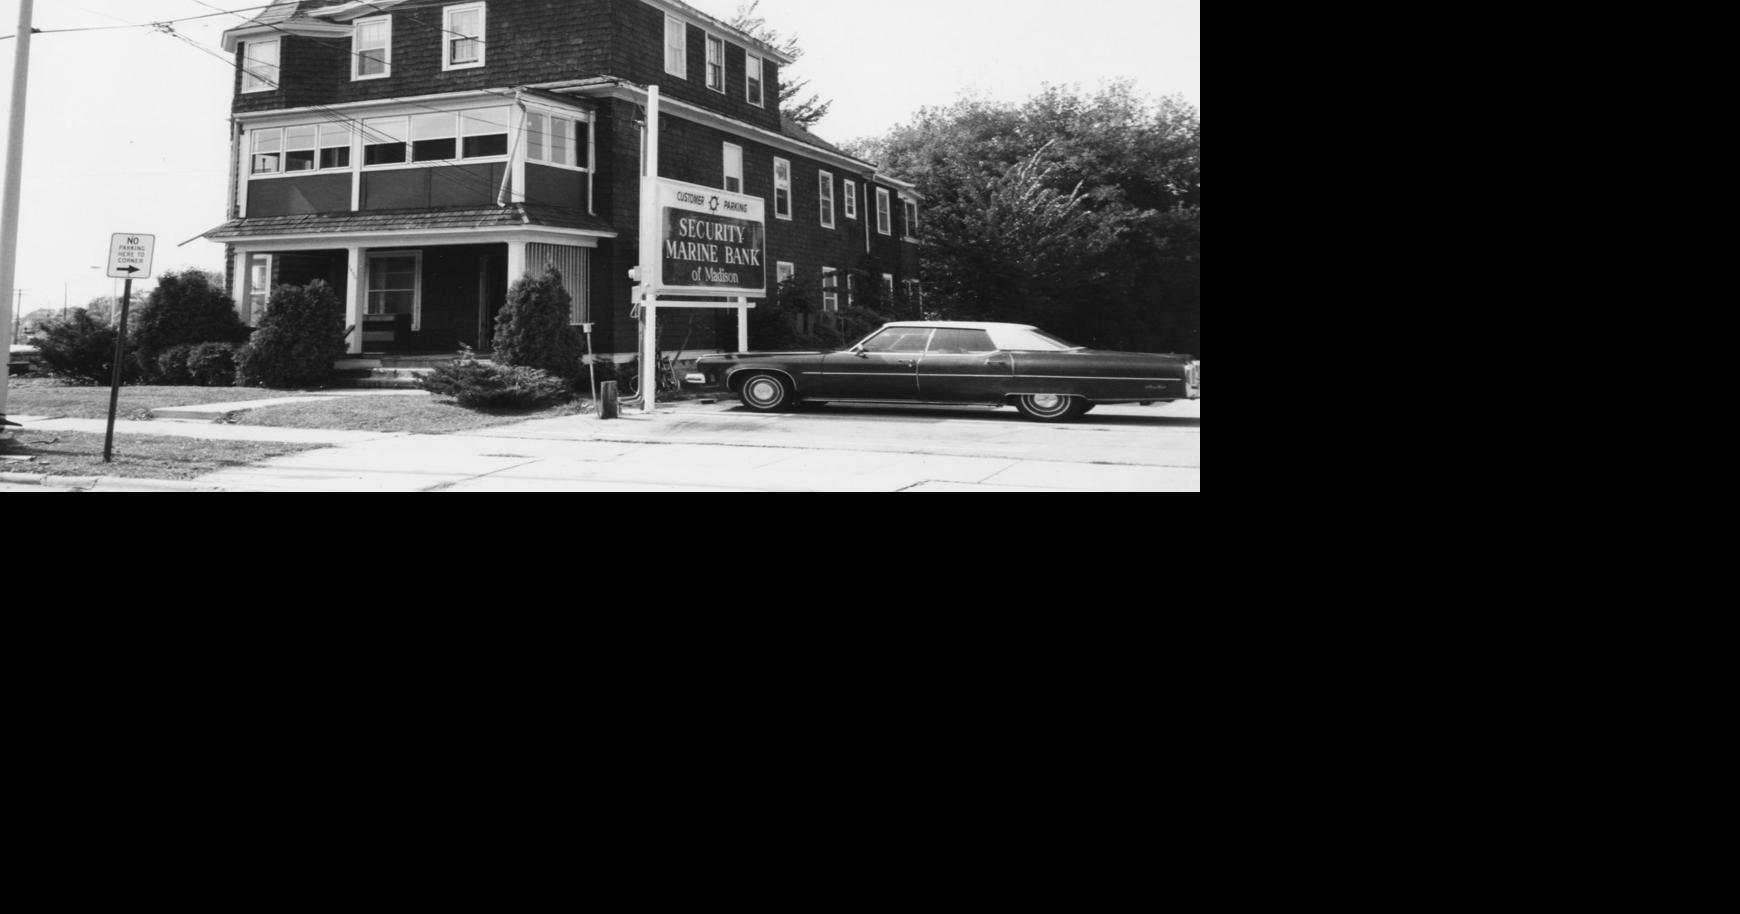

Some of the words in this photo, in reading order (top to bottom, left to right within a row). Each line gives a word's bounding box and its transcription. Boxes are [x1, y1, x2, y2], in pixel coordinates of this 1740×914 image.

[676, 191, 705, 206] CUSTOMER
[723, 200, 748, 213] PARKING
[127, 237, 139, 245] NO
[679, 217, 745, 243] SECURITY
[666, 239, 718, 263] MARINE
[725, 246, 760, 266] BANK
[691, 266, 702, 281] of
[705, 267, 739, 283] Madison
